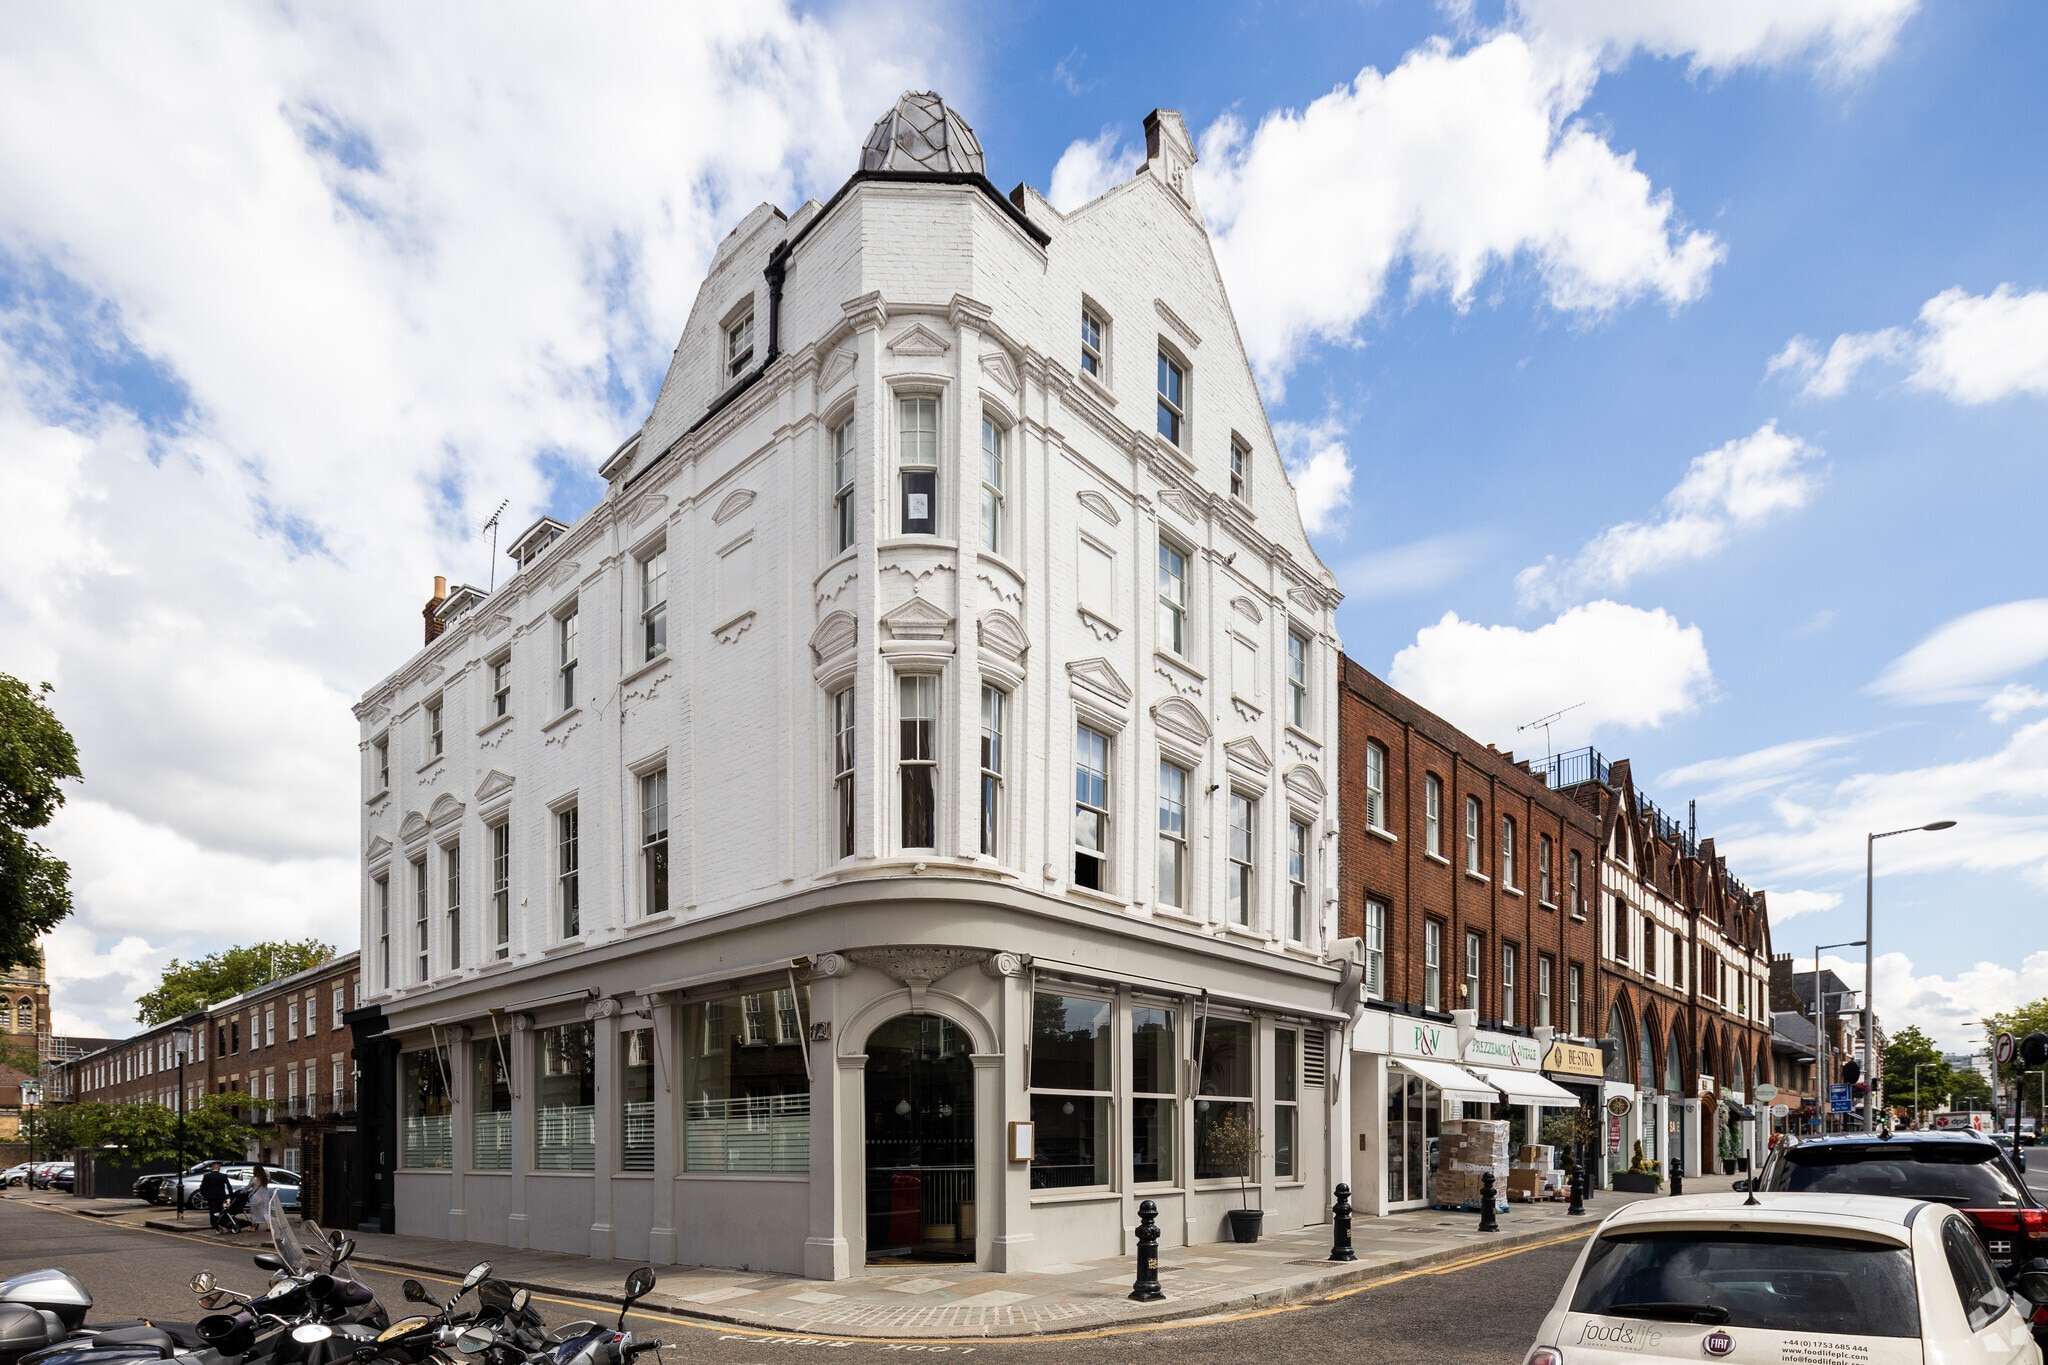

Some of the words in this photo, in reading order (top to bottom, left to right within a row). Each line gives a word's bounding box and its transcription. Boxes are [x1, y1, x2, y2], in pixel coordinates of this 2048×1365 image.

[1414, 1025, 1440, 1055] P&V
[1568, 1049, 1595, 1067] BE-STRO
[1577, 1320, 1662, 1351] food&life
[1710, 1338, 1729, 1350] FIAT
[1813, 1341, 1833, 1349] 1753
[1782, 1348, 1869, 1360] www.foodlifeplc.com
